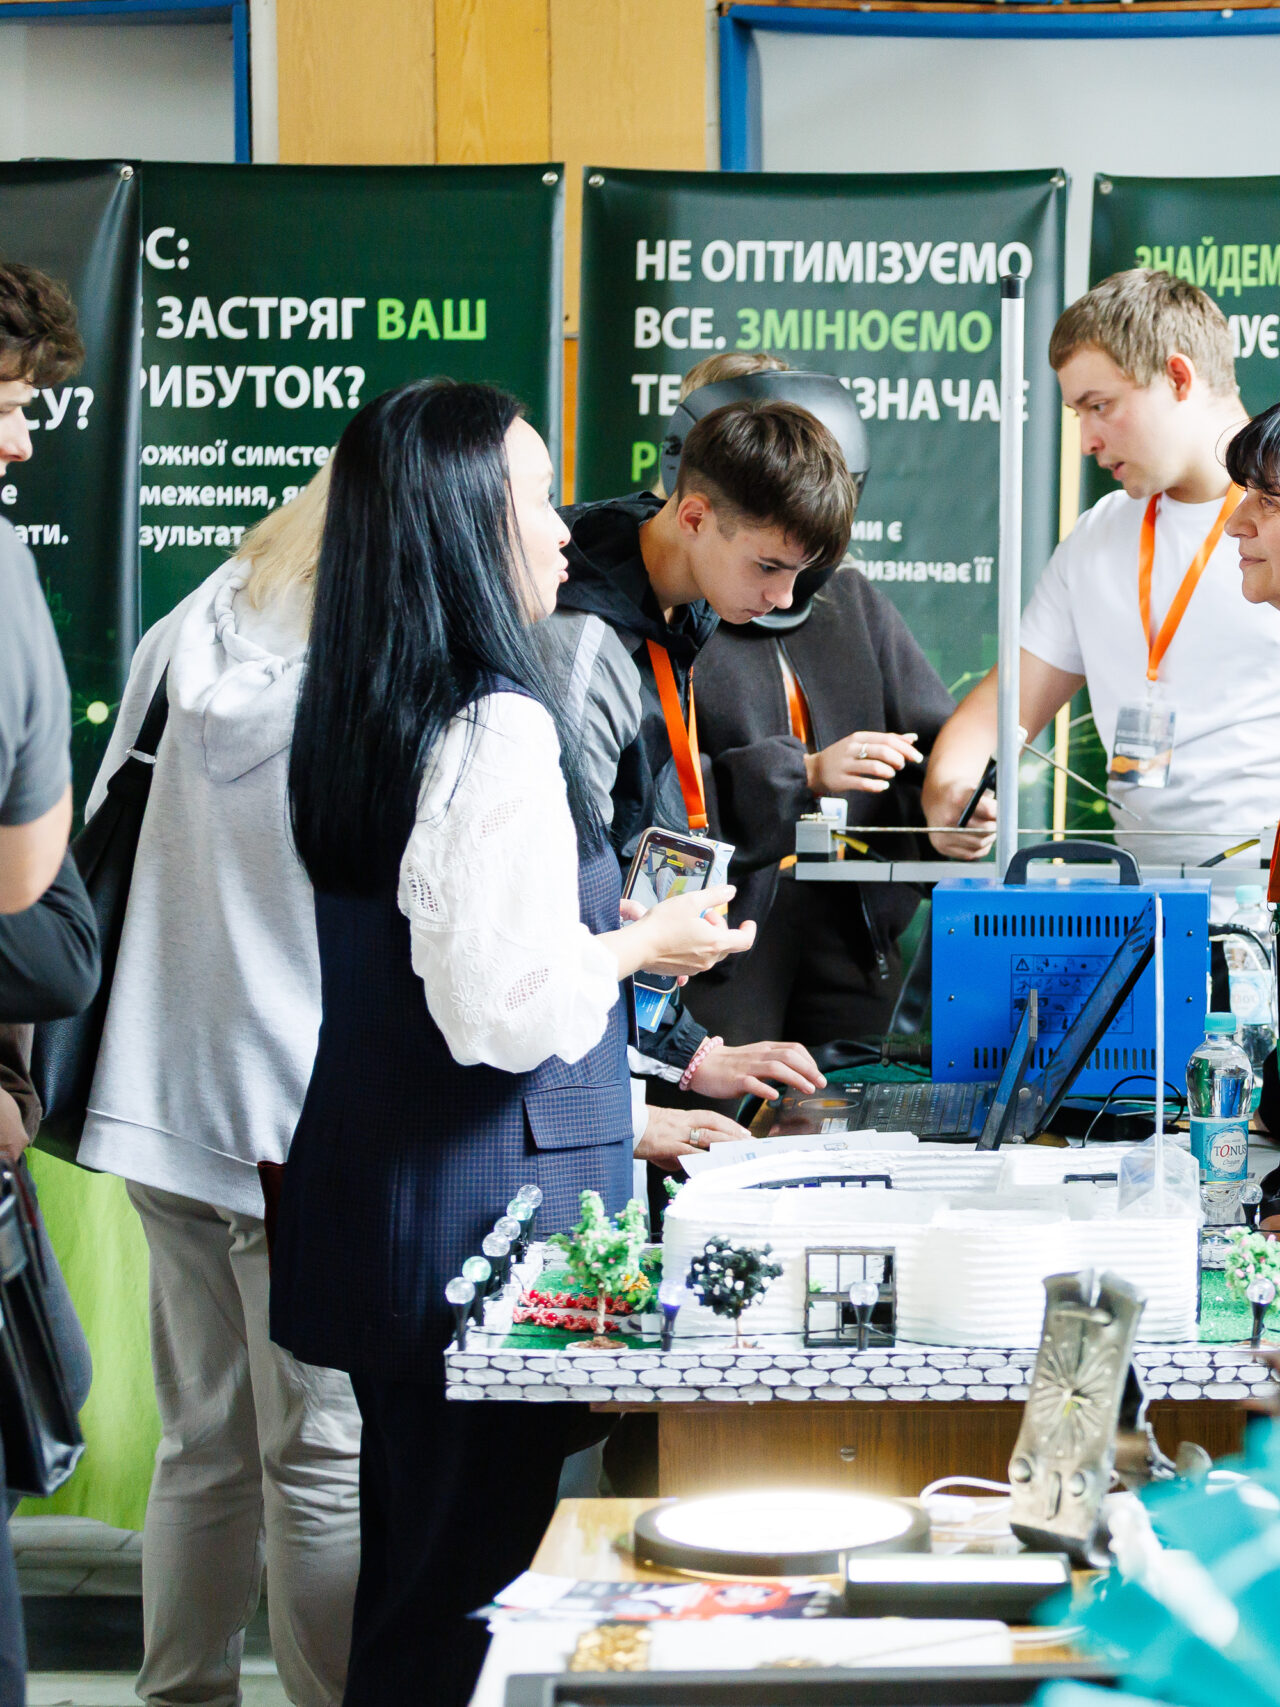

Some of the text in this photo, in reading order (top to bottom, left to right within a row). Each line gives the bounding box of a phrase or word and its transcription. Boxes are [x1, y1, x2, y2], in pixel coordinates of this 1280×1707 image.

[140, 226, 190, 270] С:
[636, 239, 1033, 284] НЕ ОПТИМІЗУЄМО
[156, 295, 366, 341] ЗАСТРЯГ
[377, 298, 487, 341] ВАШ
[635, 306, 993, 354] ВСЕ. ЗМІНЮЄМО
[973, 556, 994, 584] її
